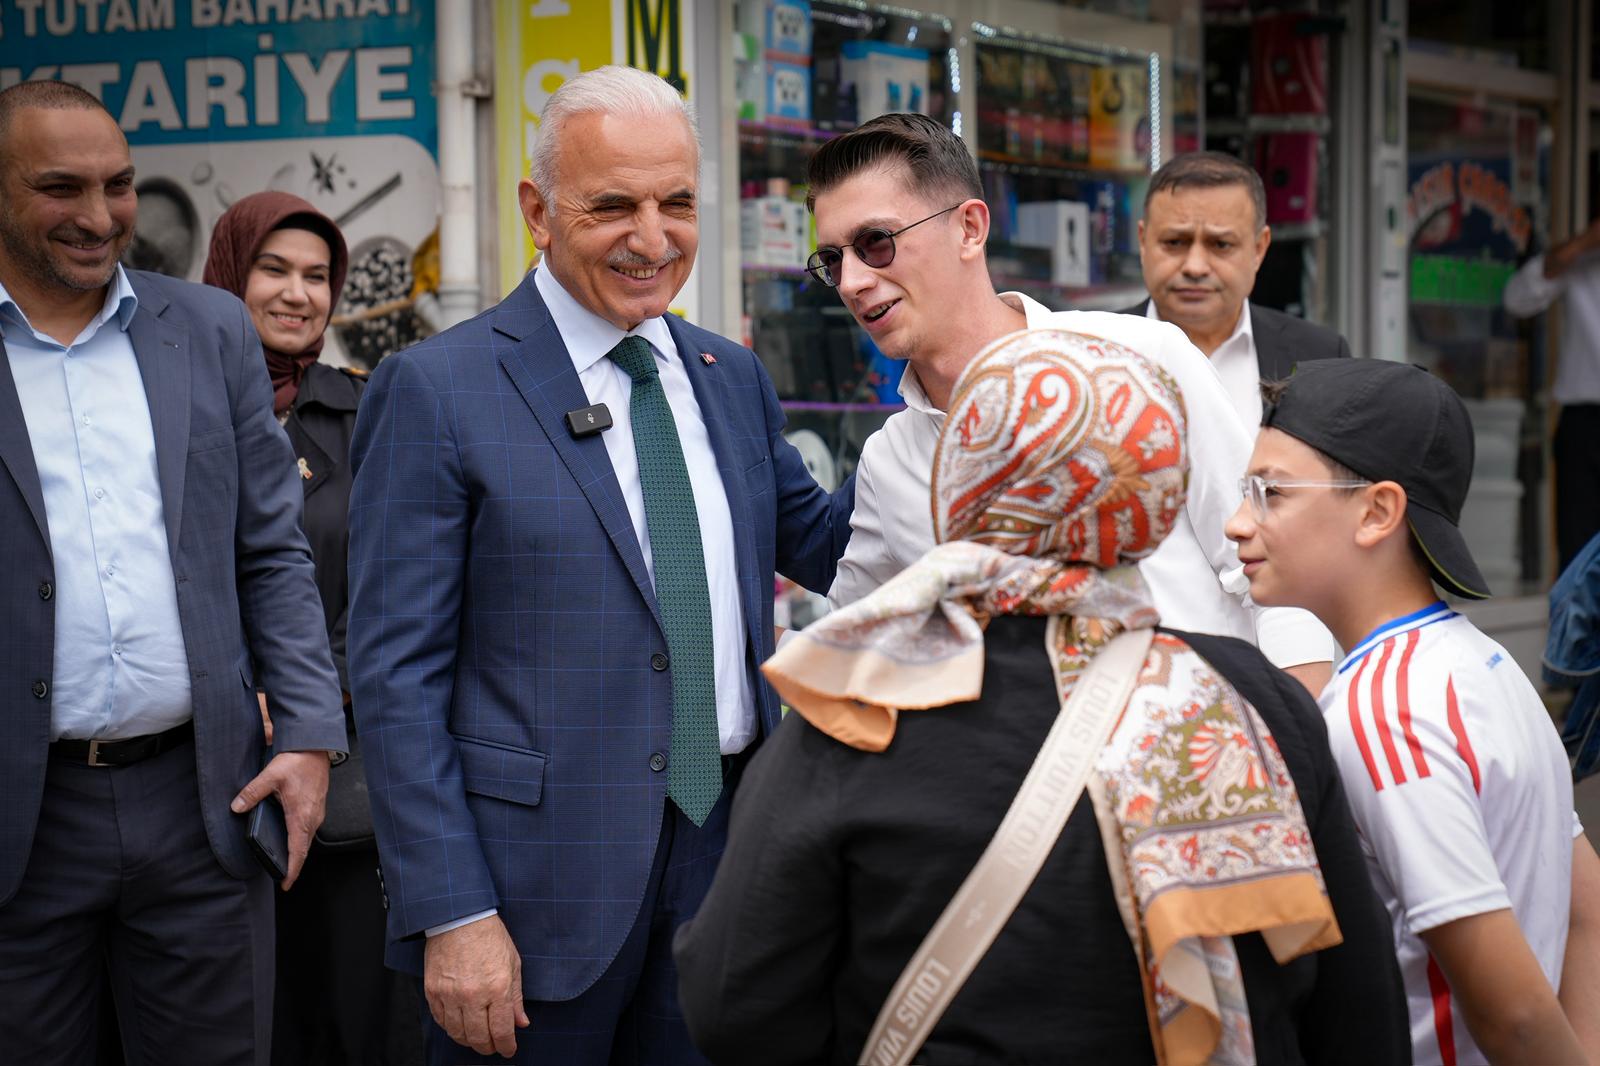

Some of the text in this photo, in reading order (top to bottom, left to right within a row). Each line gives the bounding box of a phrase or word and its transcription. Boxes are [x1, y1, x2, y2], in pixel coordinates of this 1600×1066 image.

[15, 0, 175, 37] TUTAM
[1004, 672, 1120, 872] LOUIS VUITTON
[896, 957, 952, 1030] LOUIS
